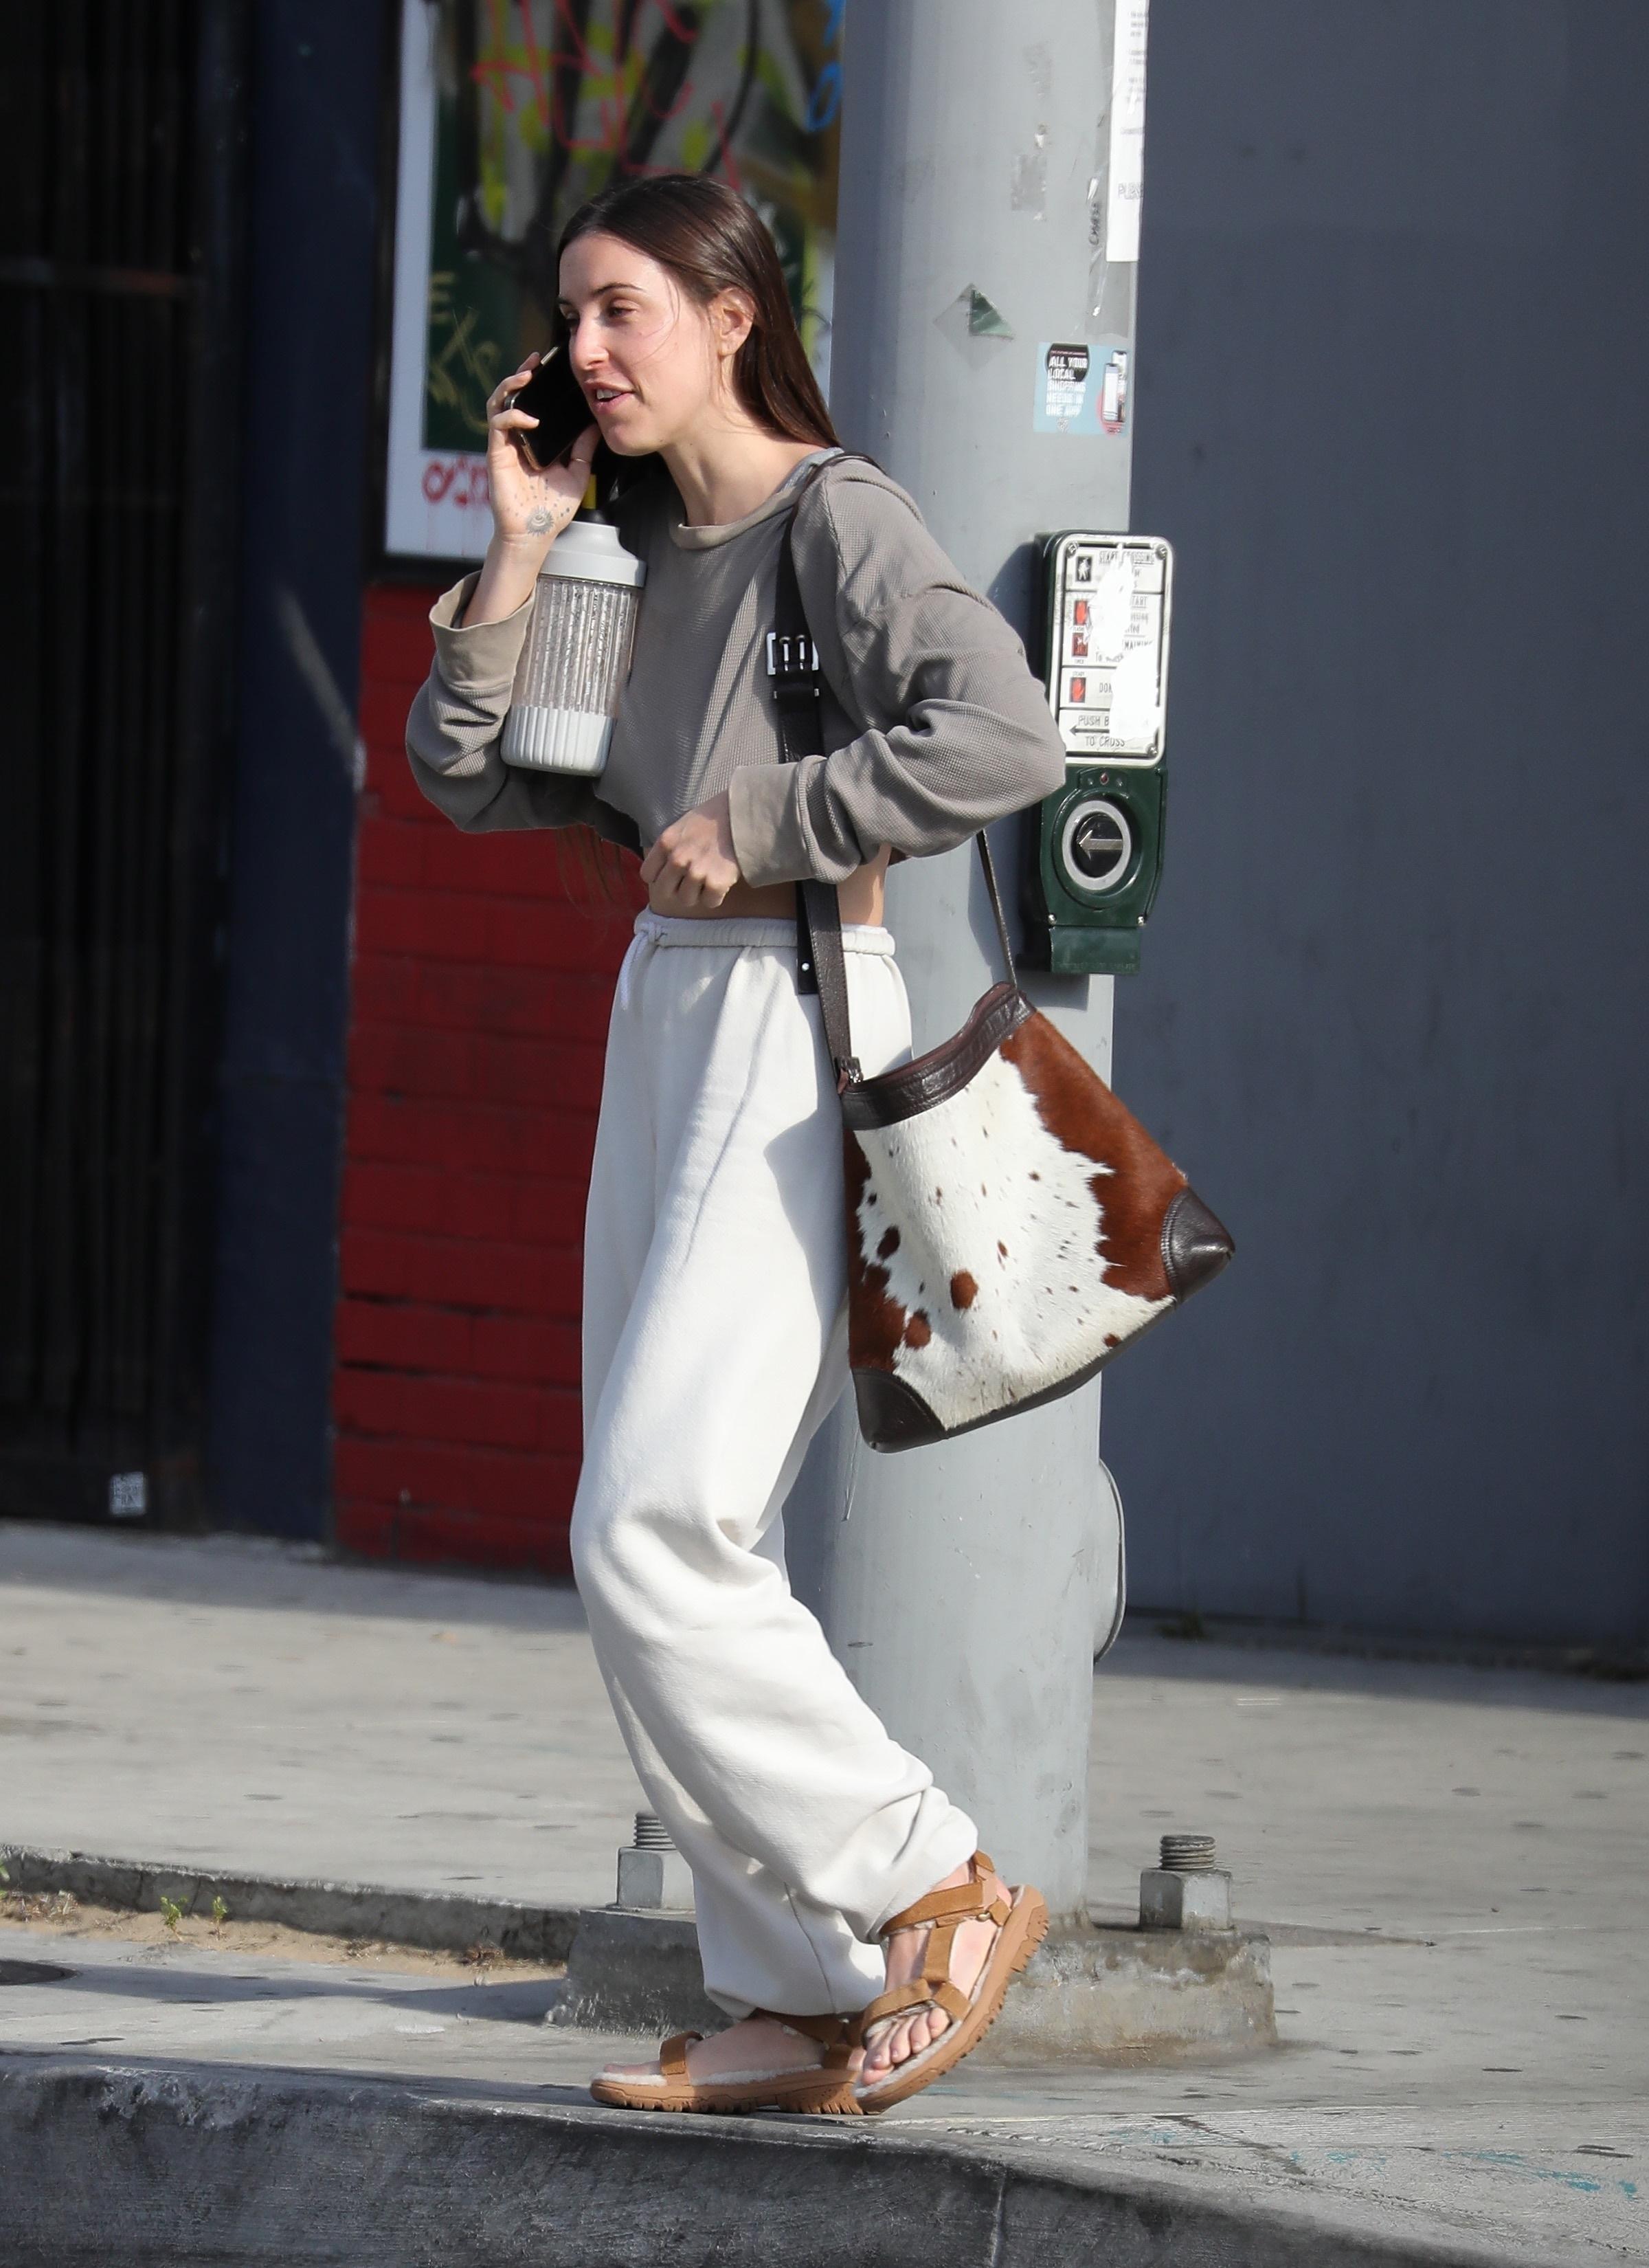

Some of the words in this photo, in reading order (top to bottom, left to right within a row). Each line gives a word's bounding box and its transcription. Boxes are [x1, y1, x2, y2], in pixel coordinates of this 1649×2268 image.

[1049, 356, 1066, 367] ALL
[1068, 357, 1088, 368] YOUR
[1047, 368, 1076, 379] LOCAL
[1132, 595, 1147, 606] TART
[1077, 715, 1101, 726] PUSH
[1086, 736, 1095, 746] TO
[1099, 736, 1125, 747] CROSS
